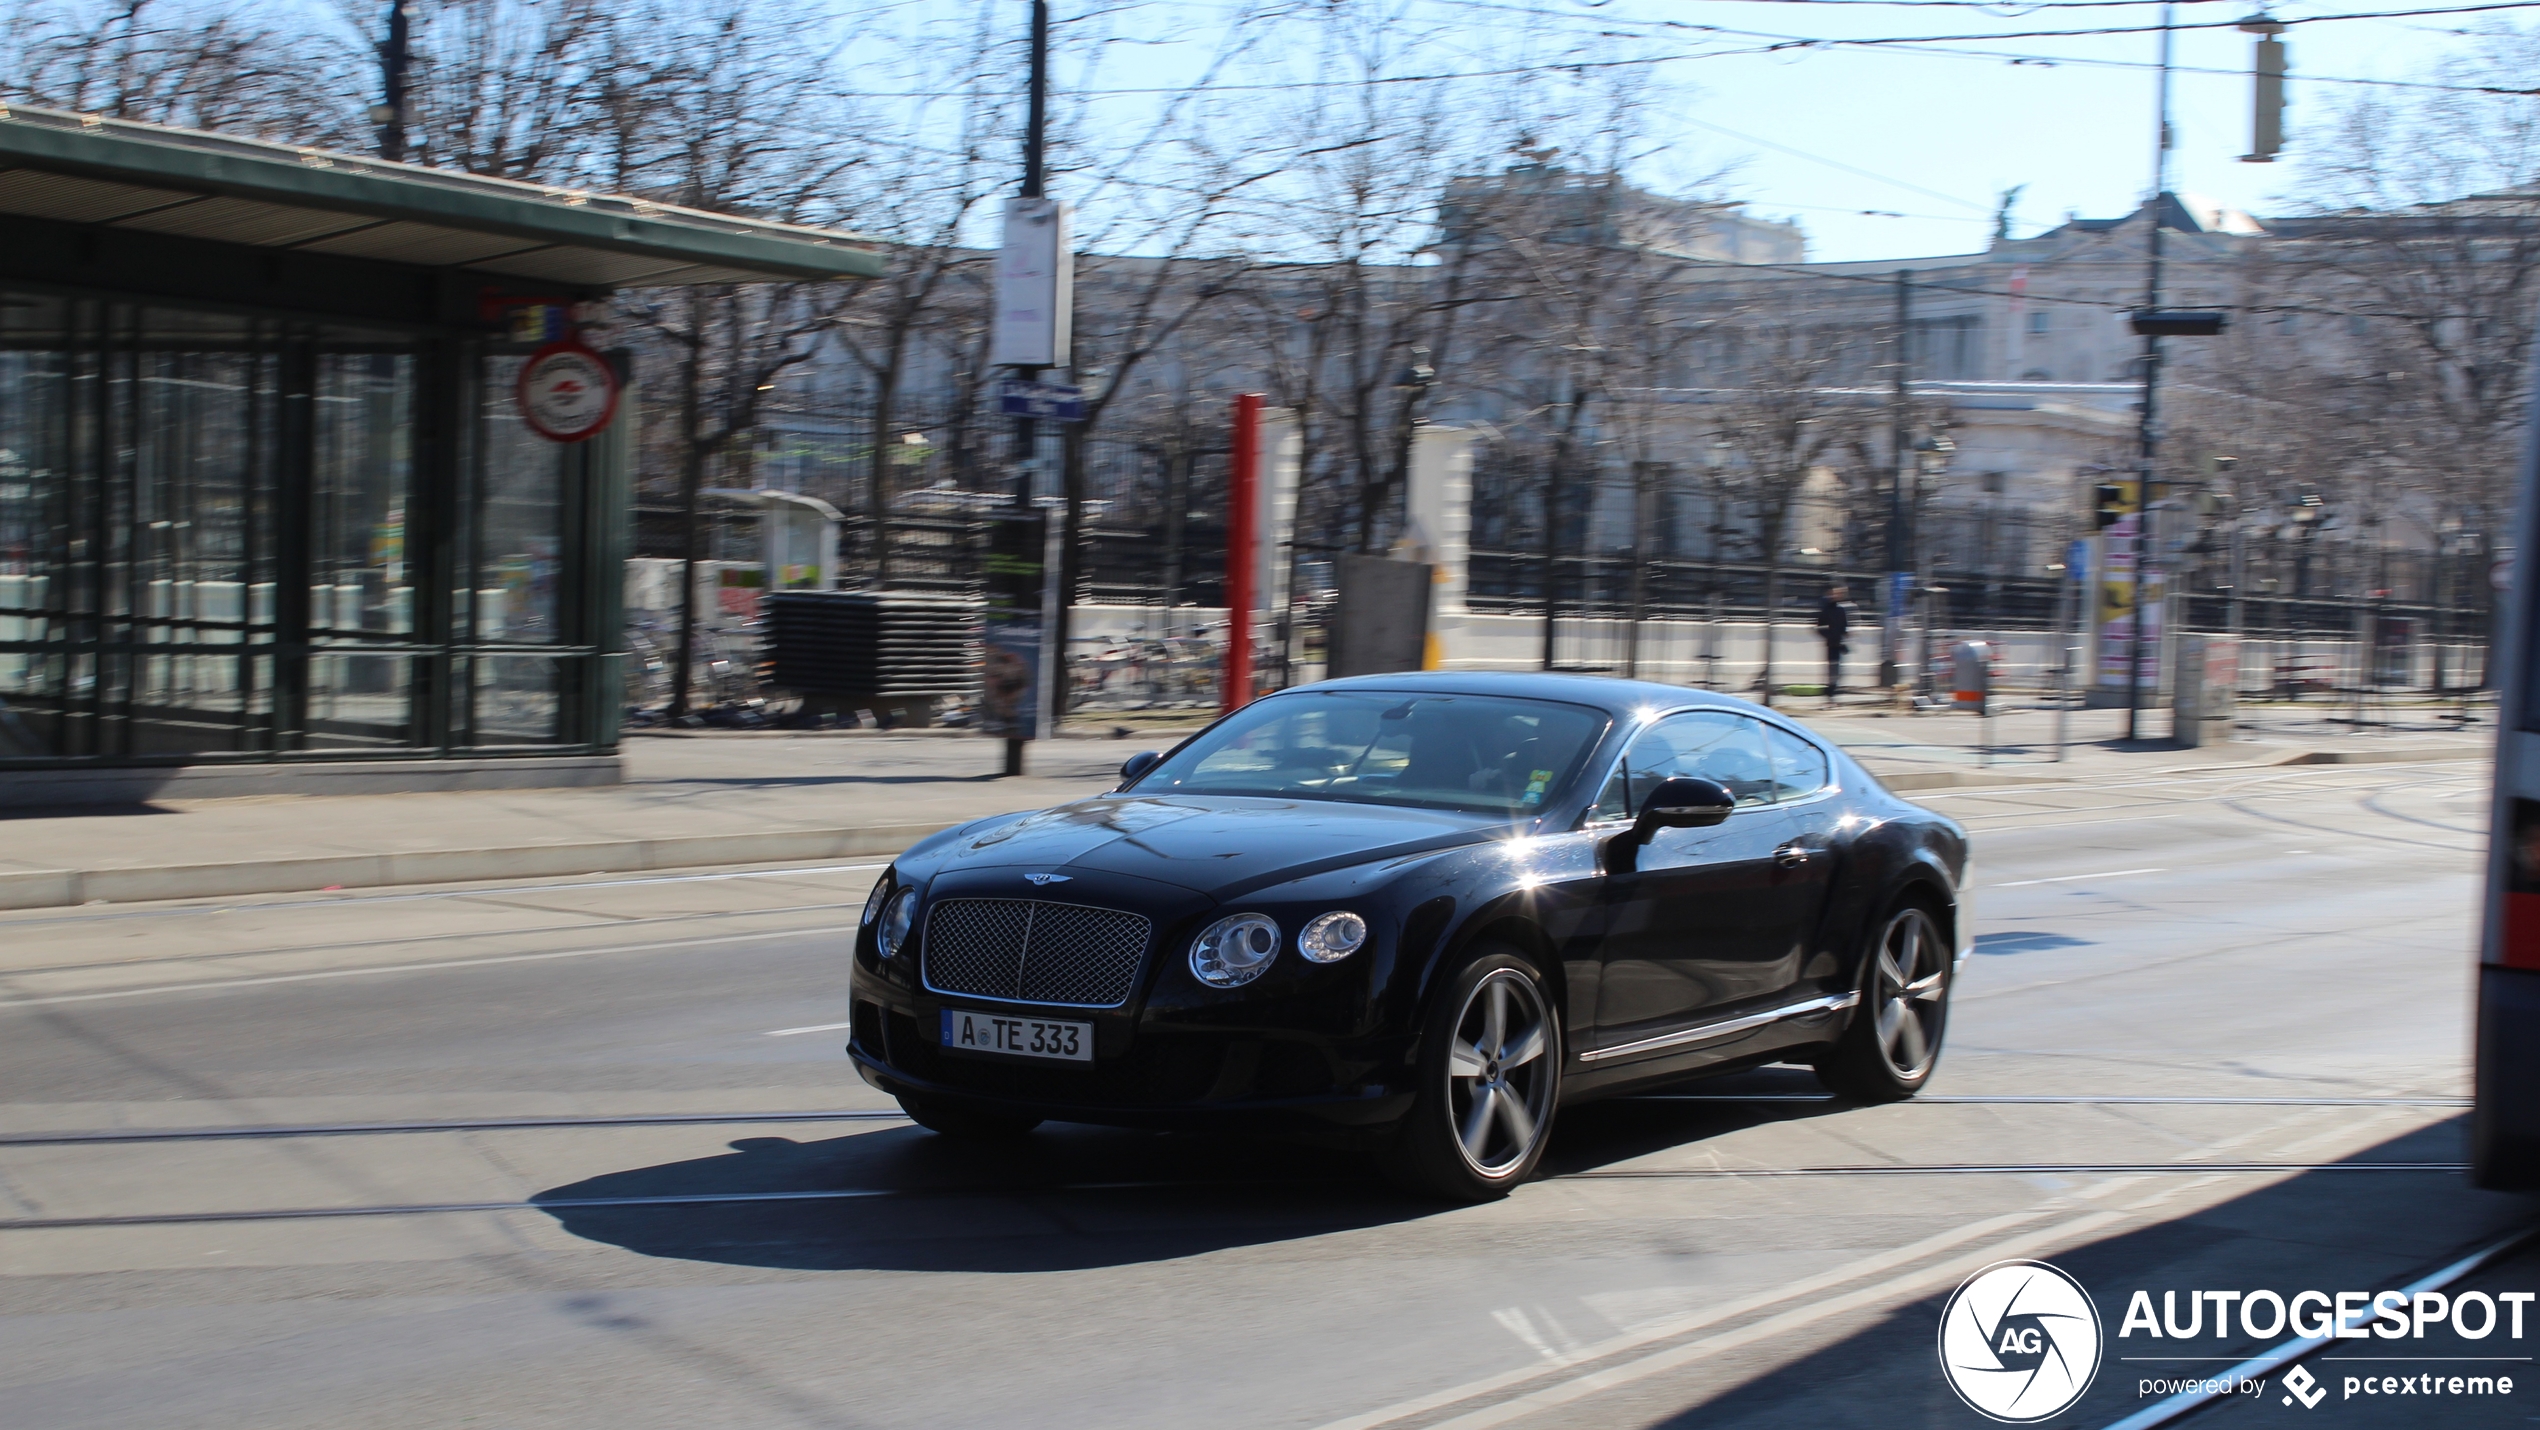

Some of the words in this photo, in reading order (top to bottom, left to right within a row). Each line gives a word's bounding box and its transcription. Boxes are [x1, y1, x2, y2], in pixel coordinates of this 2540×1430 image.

[961, 1015, 976, 1046] A
[992, 1018, 1024, 1051] TE
[1030, 1022, 1079, 1056] 333
